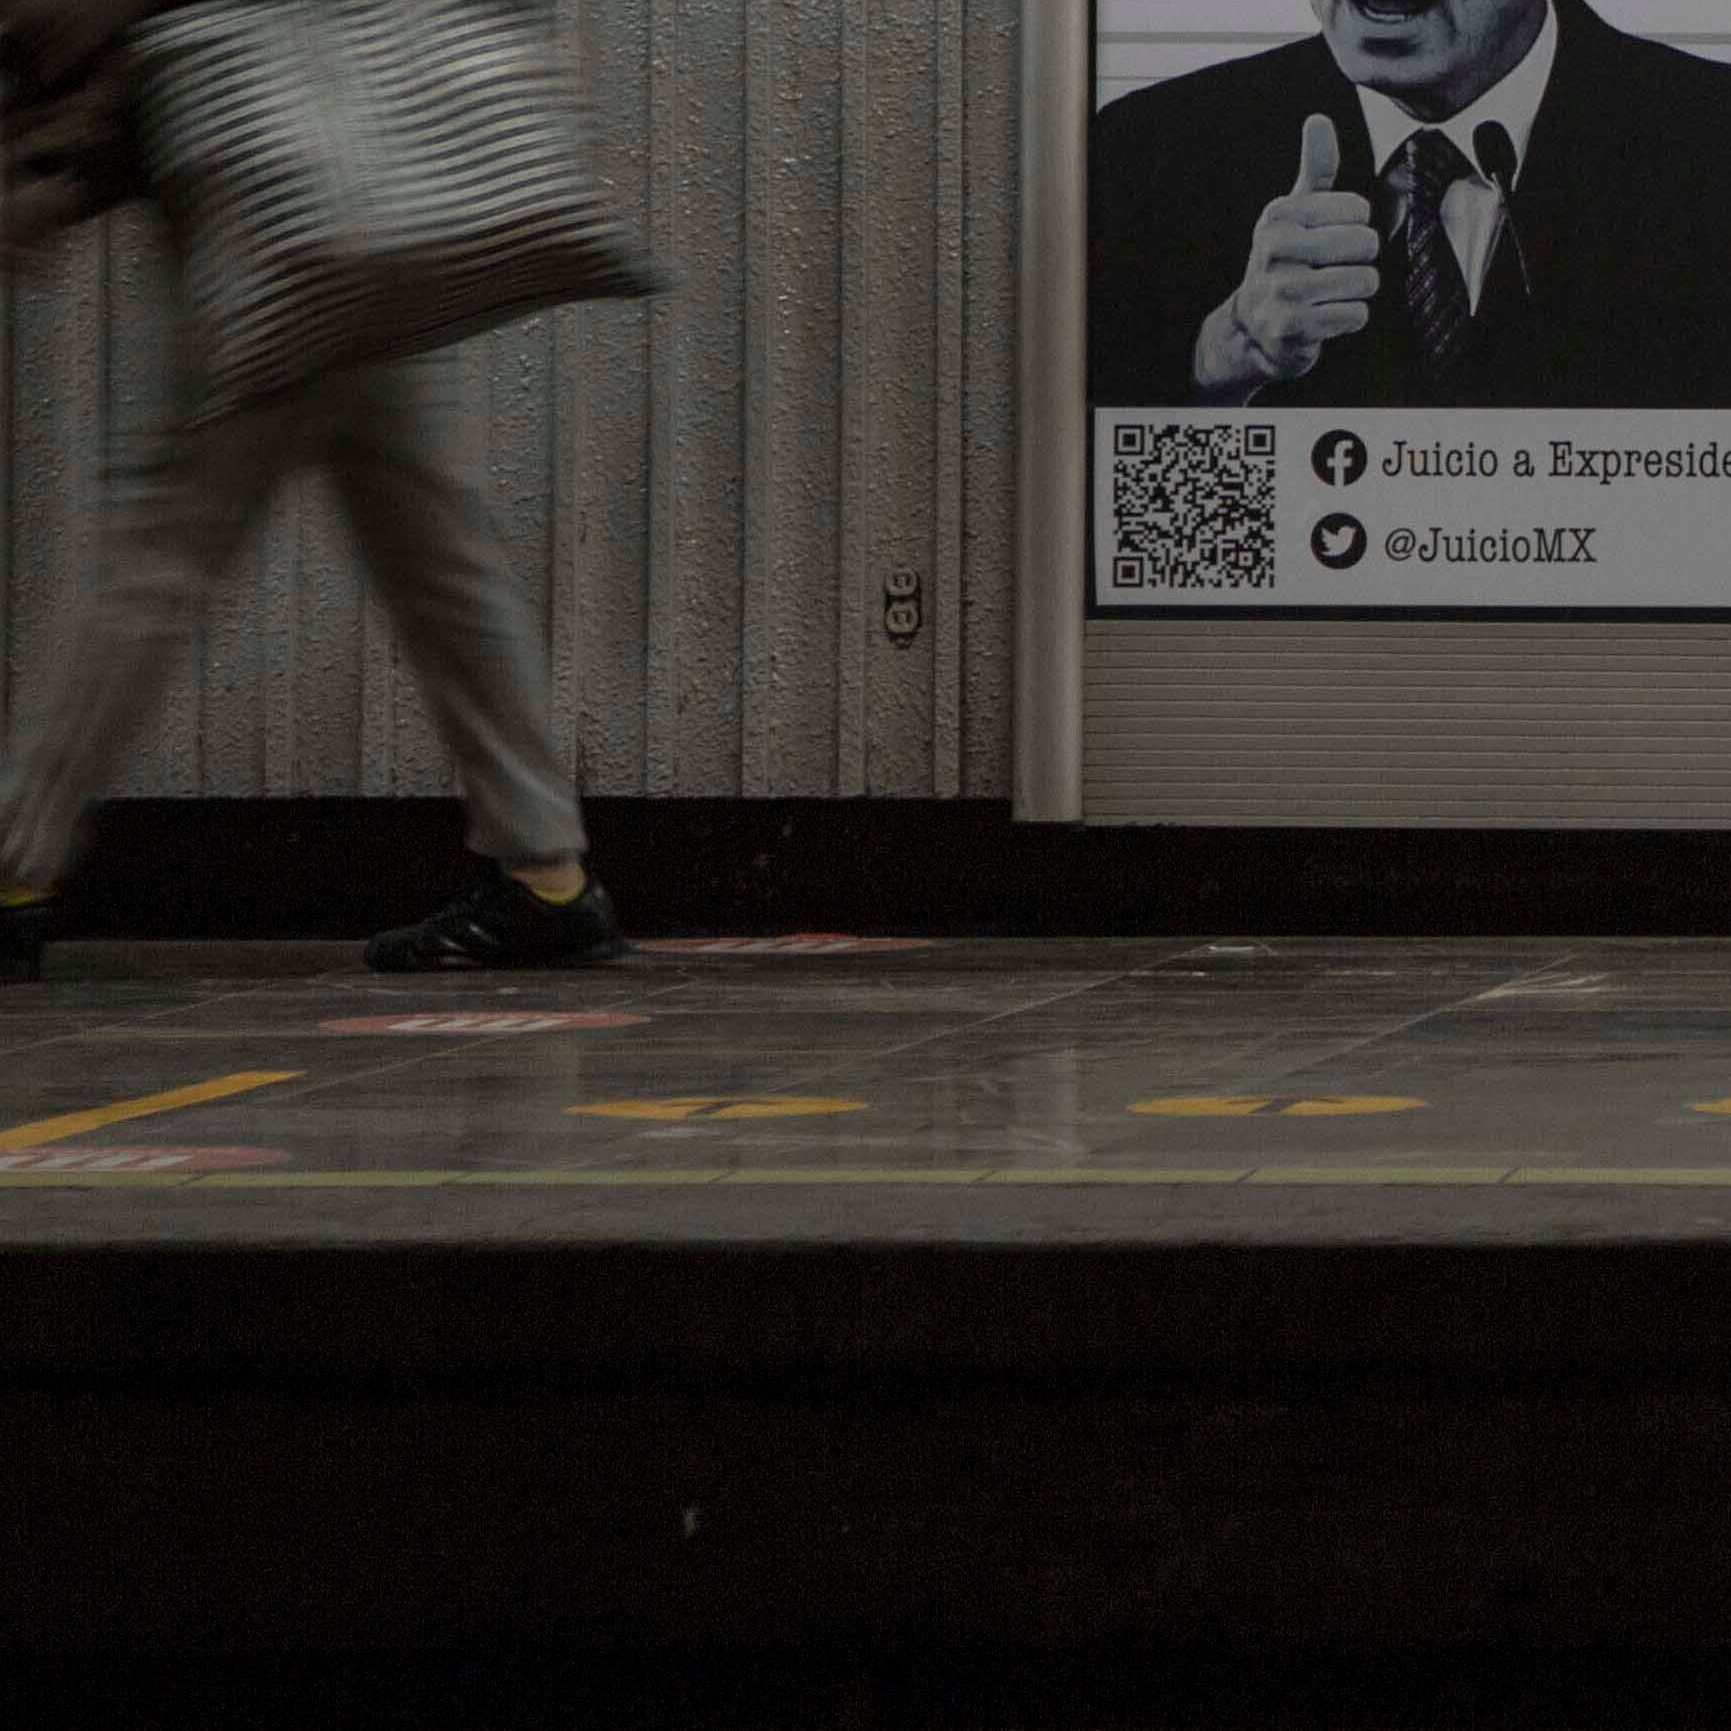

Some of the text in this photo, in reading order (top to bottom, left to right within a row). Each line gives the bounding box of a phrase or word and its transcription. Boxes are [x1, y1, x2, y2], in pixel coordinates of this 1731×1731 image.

[1382, 441, 1498, 478] Juicio
[1513, 449, 1535, 478] a
[1384, 527, 1598, 563] @JuicioMX
